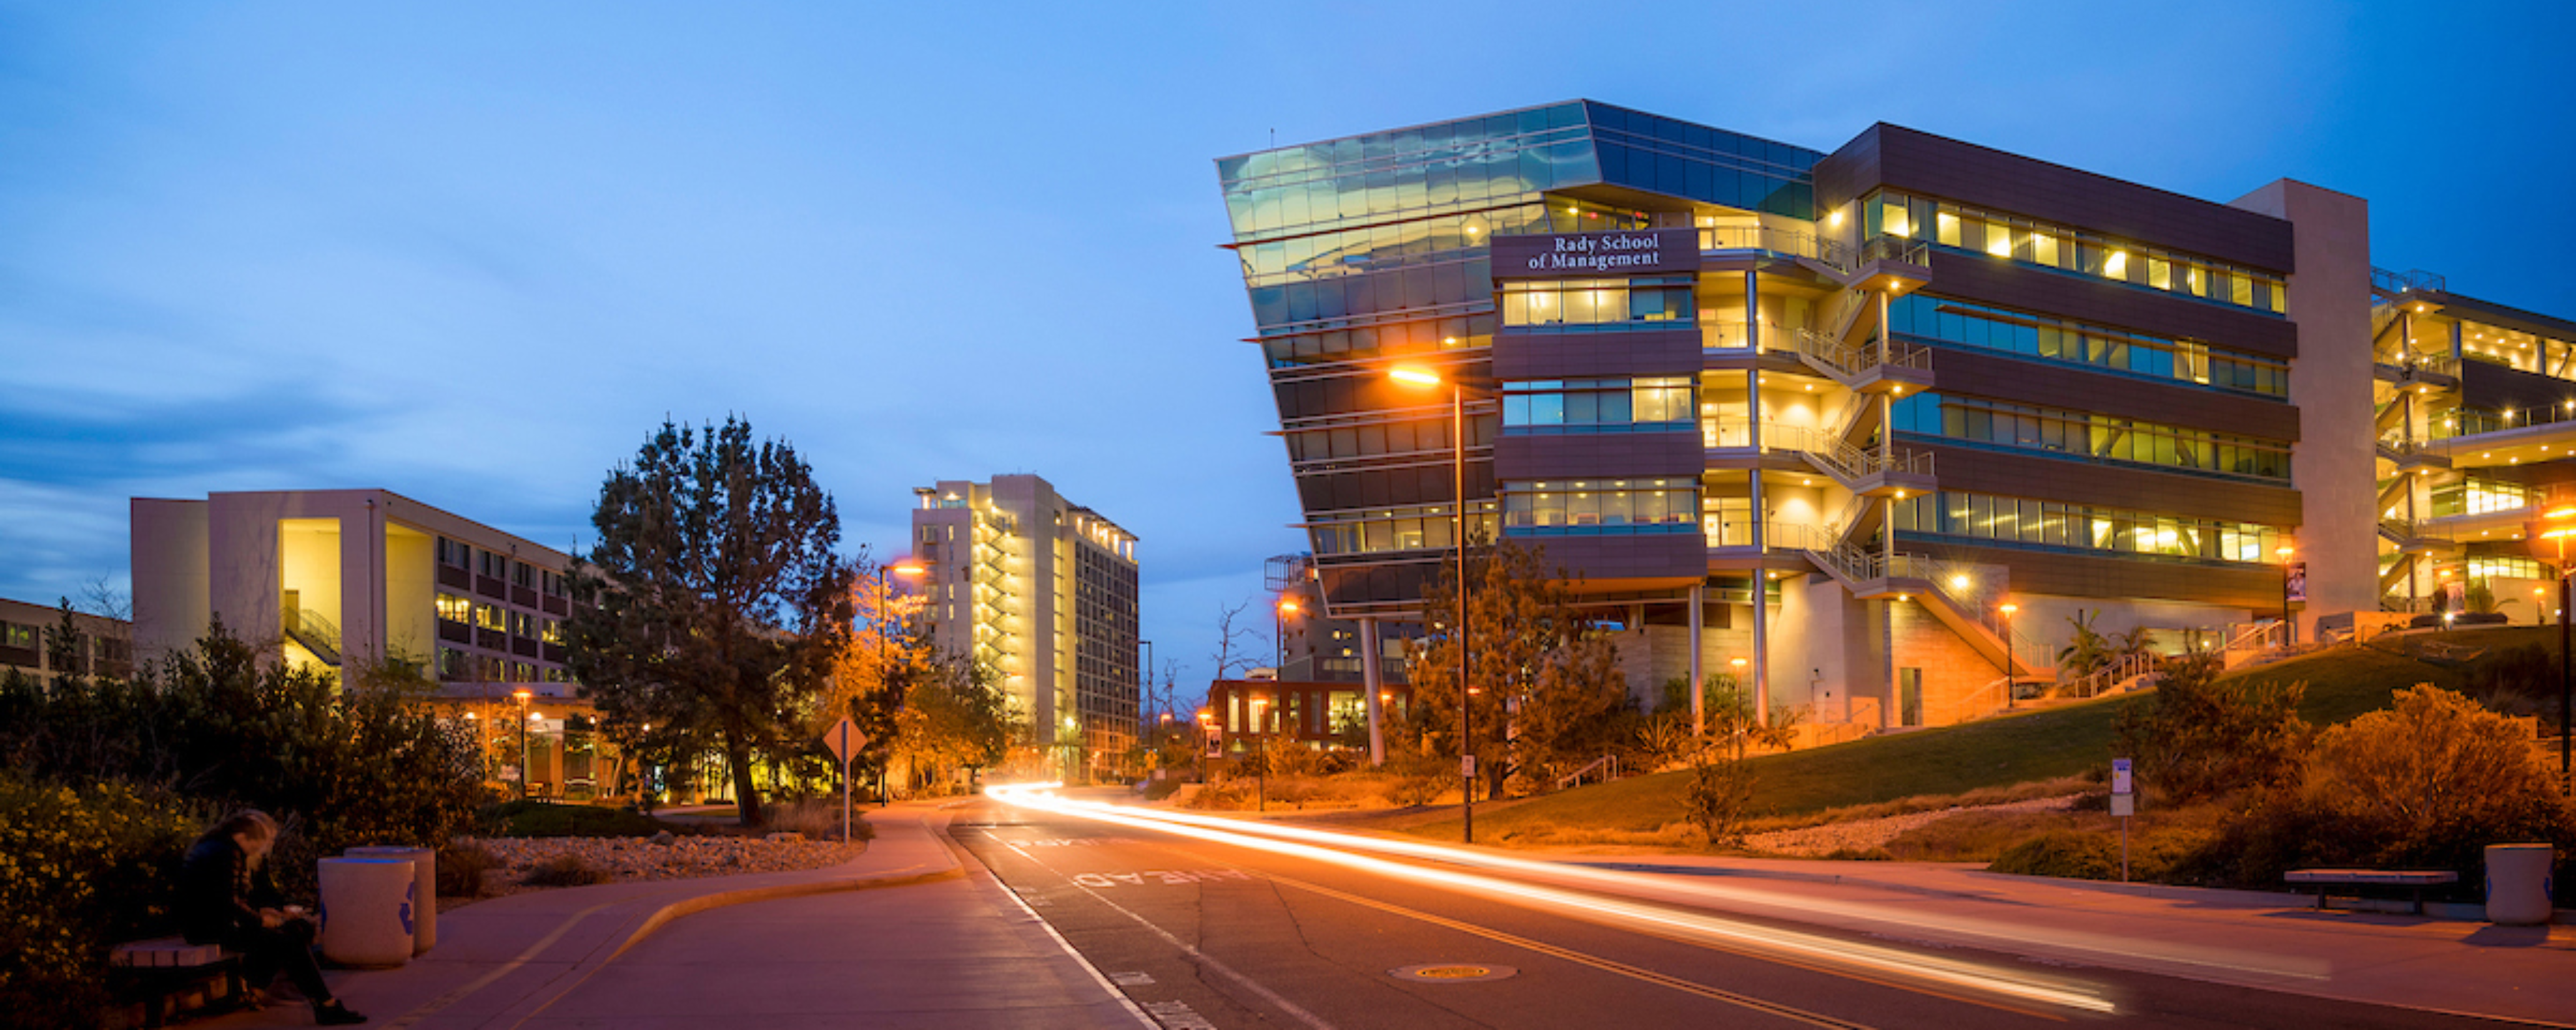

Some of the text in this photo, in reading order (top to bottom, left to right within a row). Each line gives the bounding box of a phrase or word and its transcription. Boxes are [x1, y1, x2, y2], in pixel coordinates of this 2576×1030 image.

[1554, 233, 1659, 255] Rady School
[1527, 251, 1659, 270] of Management
